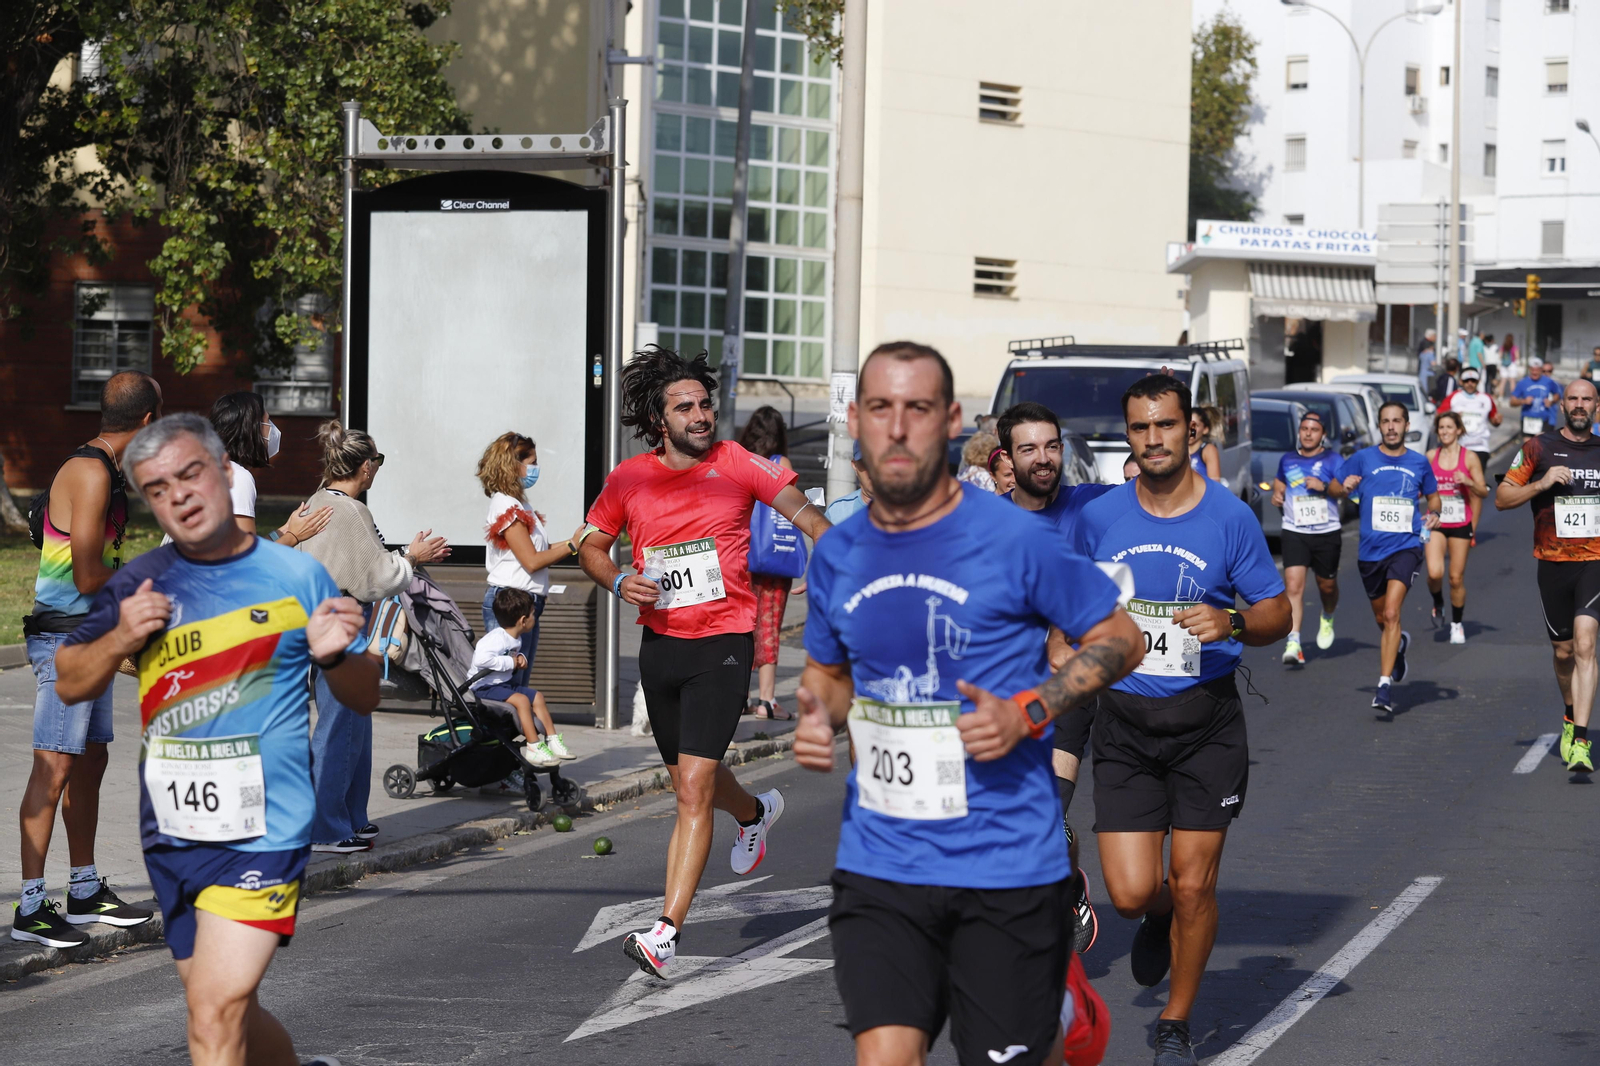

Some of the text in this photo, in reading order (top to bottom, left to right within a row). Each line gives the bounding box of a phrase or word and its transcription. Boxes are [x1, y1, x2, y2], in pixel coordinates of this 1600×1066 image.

[453, 200, 510, 209] Clear Channel
[1219, 225, 1294, 238] CHURROS
[1239, 238, 1371, 253] PATATAS FRITAS
[1569, 468, 1600, 480] TREM
[1300, 506, 1317, 517] 136
[1380, 510, 1400, 523] 565
[1442, 506, 1454, 515] 80
[1563, 512, 1586, 526] 421
[680, 546, 685, 555] A
[685, 541, 711, 554] HUELVA
[1127, 543, 1163, 557] VUELTA
[1164, 544, 1172, 553] A
[1172, 546, 1208, 571] HUELVA
[661, 567, 694, 592] 601
[1129, 601, 1156, 616] VUELTA
[1157, 605, 1164, 616] A
[159, 630, 202, 668] CLUB
[1143, 630, 1168, 656] 04
[164, 743, 199, 760] VUELTA
[200, 744, 210, 760] A
[210, 740, 252, 760] HUELVA
[870, 745, 914, 786] 203
[167, 780, 220, 813] 146
